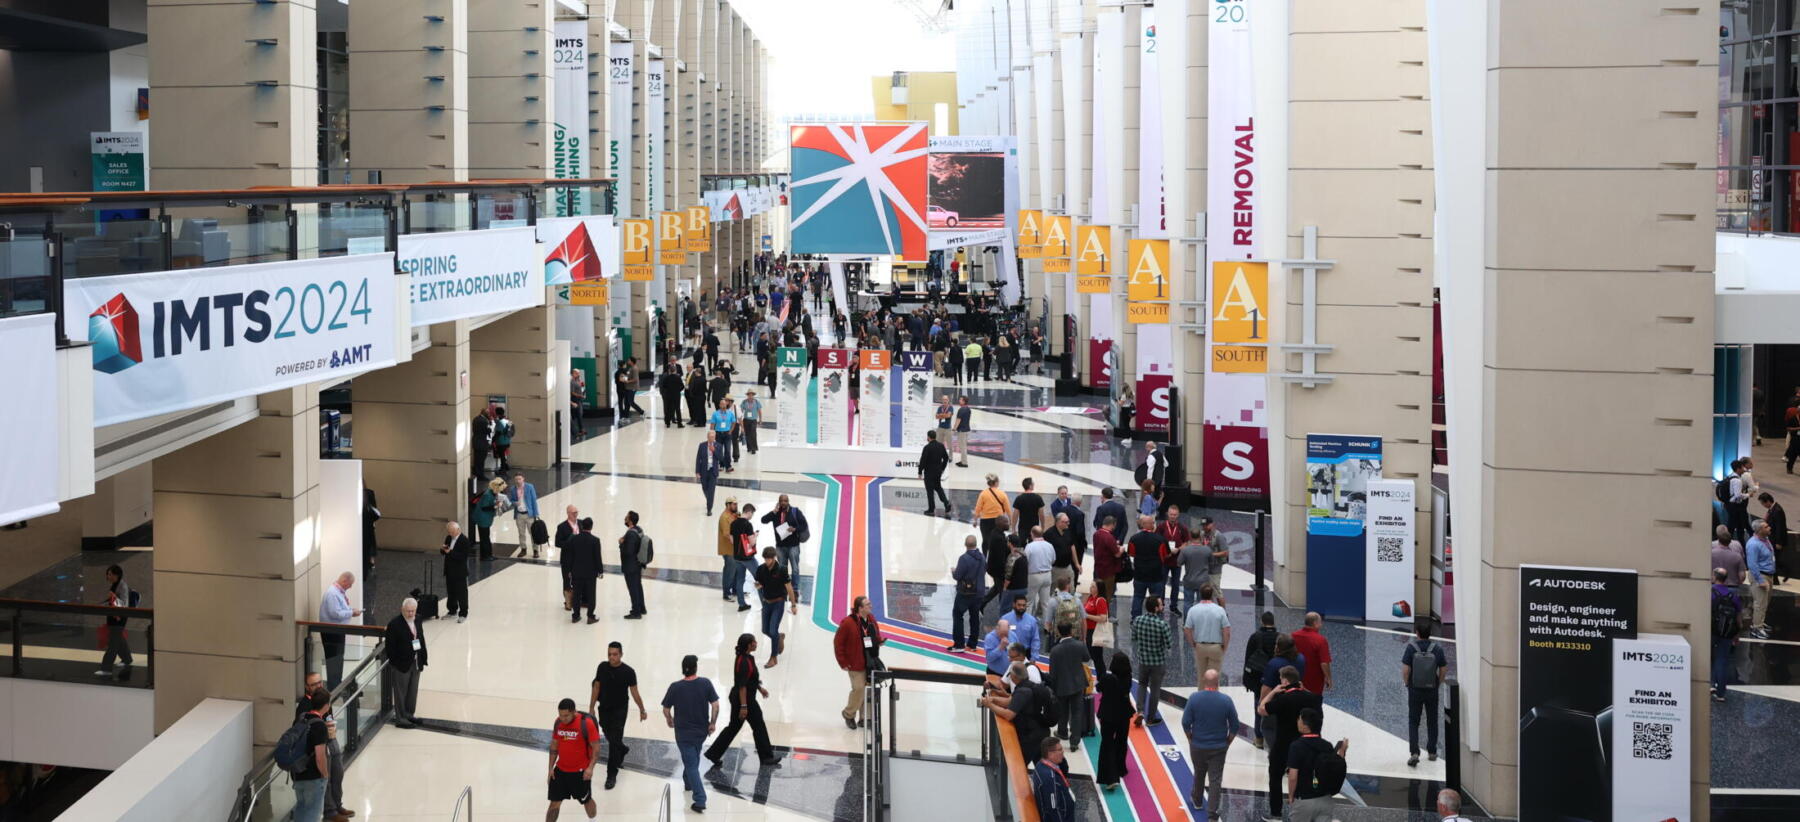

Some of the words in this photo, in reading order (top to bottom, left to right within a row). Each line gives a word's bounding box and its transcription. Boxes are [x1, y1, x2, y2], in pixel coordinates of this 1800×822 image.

[555, 39, 583, 48] IMTS
[554, 50, 584, 63] 024
[610, 57, 629, 66] MTS
[965, 140, 992, 148] STAGE
[1233, 117, 1254, 246] REMOVAL
[661, 252, 685, 260] NORTH
[1044, 260, 1070, 268] SOUTH
[625, 267, 653, 276] NORTH
[419, 271, 529, 302] EXTRAORDINARY
[1078, 279, 1111, 287] SOUTH
[572, 289, 606, 297] NORTH
[1130, 306, 1167, 316] SOUTH
[153, 278, 372, 358] IMTS2024
[786, 350, 798, 362] N
[828, 351, 838, 363] S
[871, 353, 880, 364] E
[910, 354, 926, 366] W
[1215, 350, 1265, 361] SOUTH
[275, 361, 316, 376] POWERED
[317, 358, 329, 368] BY
[1220, 441, 1255, 481] S
[1370, 490, 1411, 498] IMTS2024
[1543, 579, 1606, 591] AUTODESK
[1529, 602, 1568, 614] Design,
[1569, 605, 1616, 615] engineer
[1529, 615, 1549, 623] and
[1551, 616, 1579, 625] make
[1581, 618, 1628, 630] anything
[1529, 626, 1552, 634] with
[1554, 627, 1606, 638] Autodesk.
[1529, 640, 1554, 648] Booth
[1555, 642, 1592, 651] #133310
[1622, 651, 1684, 664] IMTS2024
[1634, 689, 1657, 698] FIND
[1629, 697, 1678, 706] EXHIBITOR
